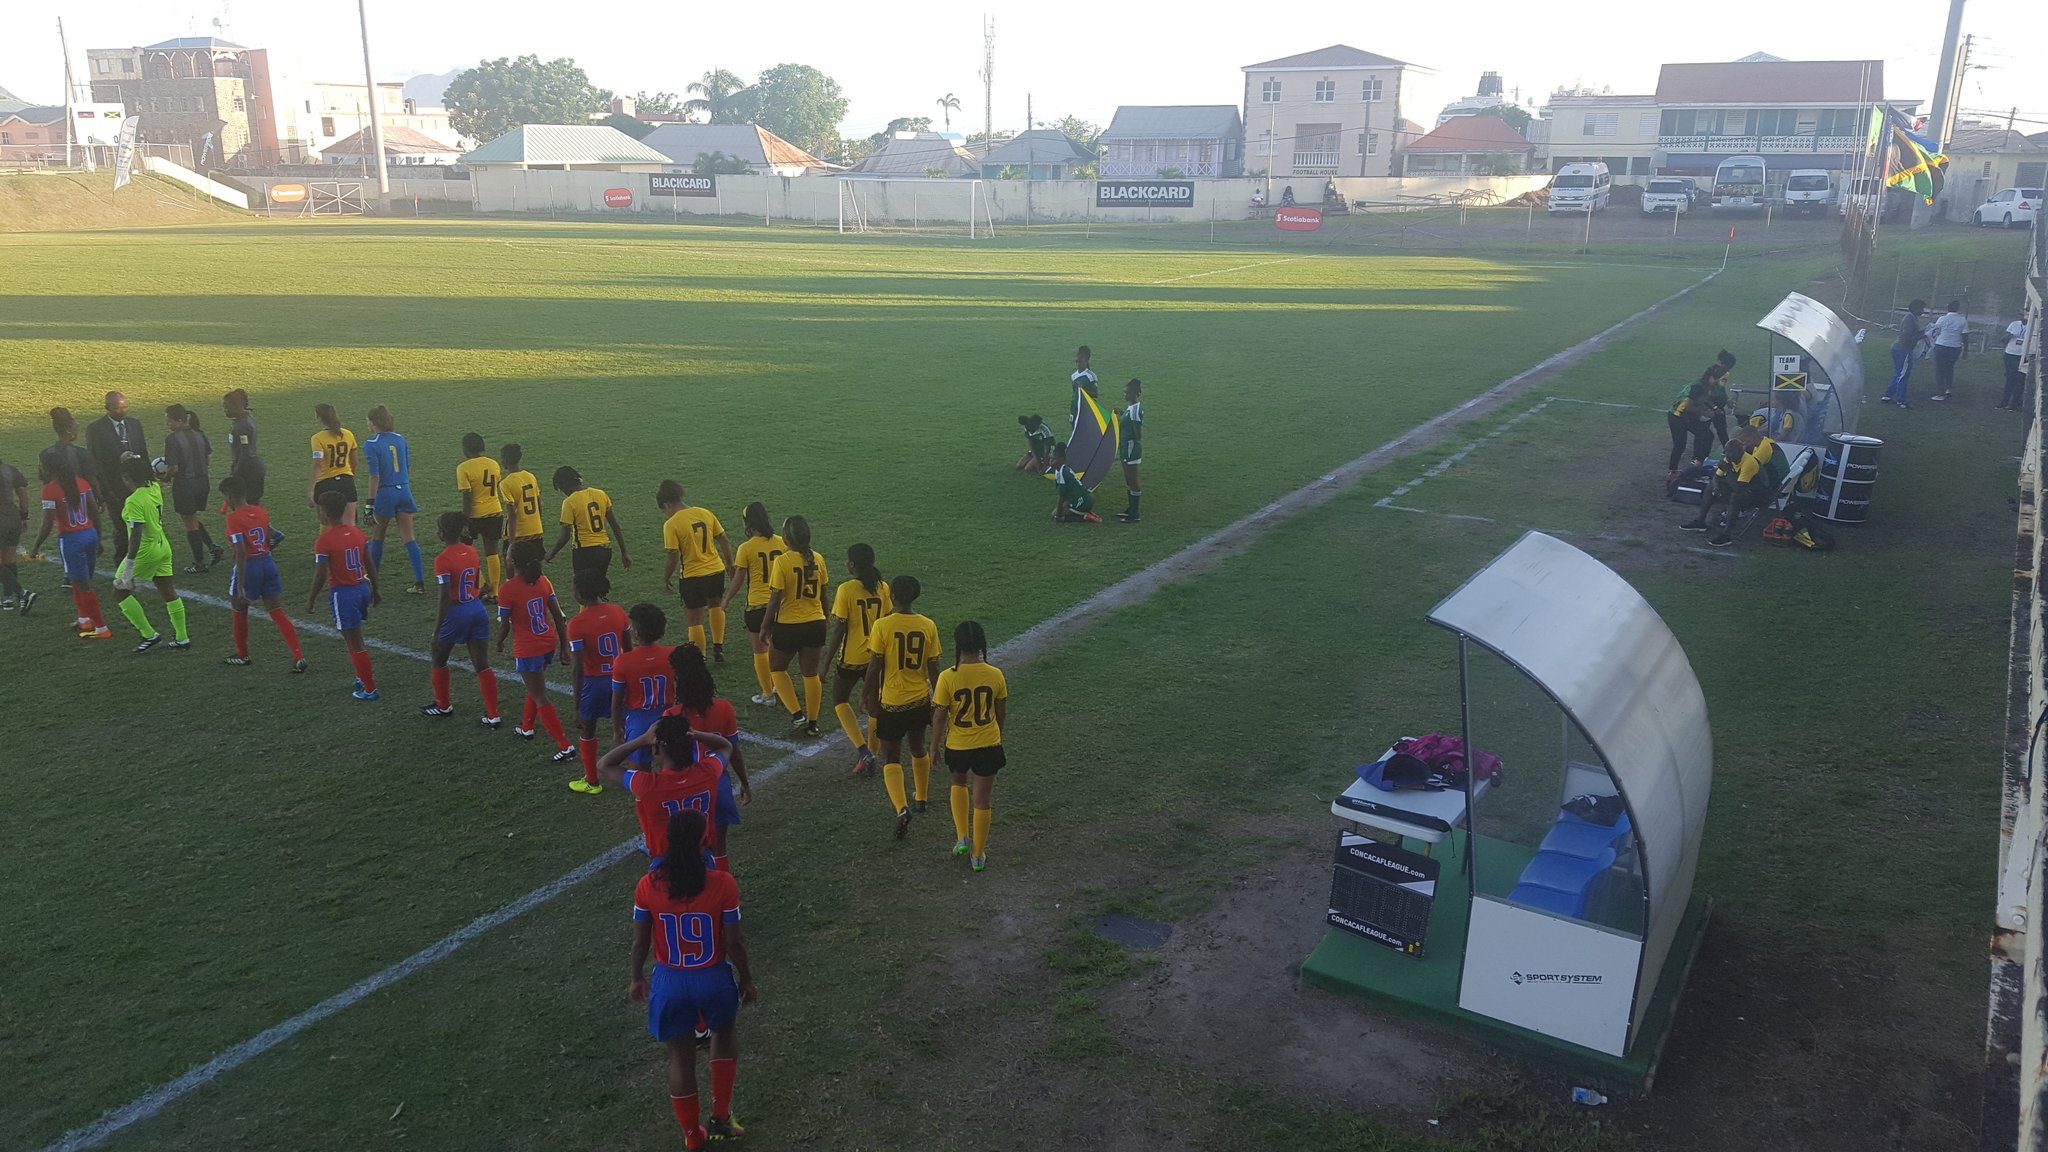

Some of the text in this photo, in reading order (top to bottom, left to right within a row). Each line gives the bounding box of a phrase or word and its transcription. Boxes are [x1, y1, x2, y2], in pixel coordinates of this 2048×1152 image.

[652, 177, 711, 189] BLACKCARD
[1100, 186, 1190, 199] BLACKCARD
[1283, 215, 1320, 223] Scotiabank
[327, 441, 349, 469] 18
[389, 444, 400, 474] 1
[482, 469, 496, 497] 4
[522, 483, 536, 515] 5
[587, 501, 604, 533] 6
[692, 521, 707, 554] 7
[345, 546, 363, 581] 4
[458, 568, 475, 603] 6
[793, 566, 819, 602] 15
[528, 597, 549, 635] 8
[857, 597, 882, 637] 17
[597, 631, 619, 673] 9
[894, 630, 925, 671] 19
[639, 674, 668, 711] 11
[952, 686, 994, 729] 20
[1350, 847, 1426, 879] CONCACAFLEAGUE.com
[658, 912, 715, 968] 19
[1331, 914, 1402, 946] CONCACAFLEAGUE.com
